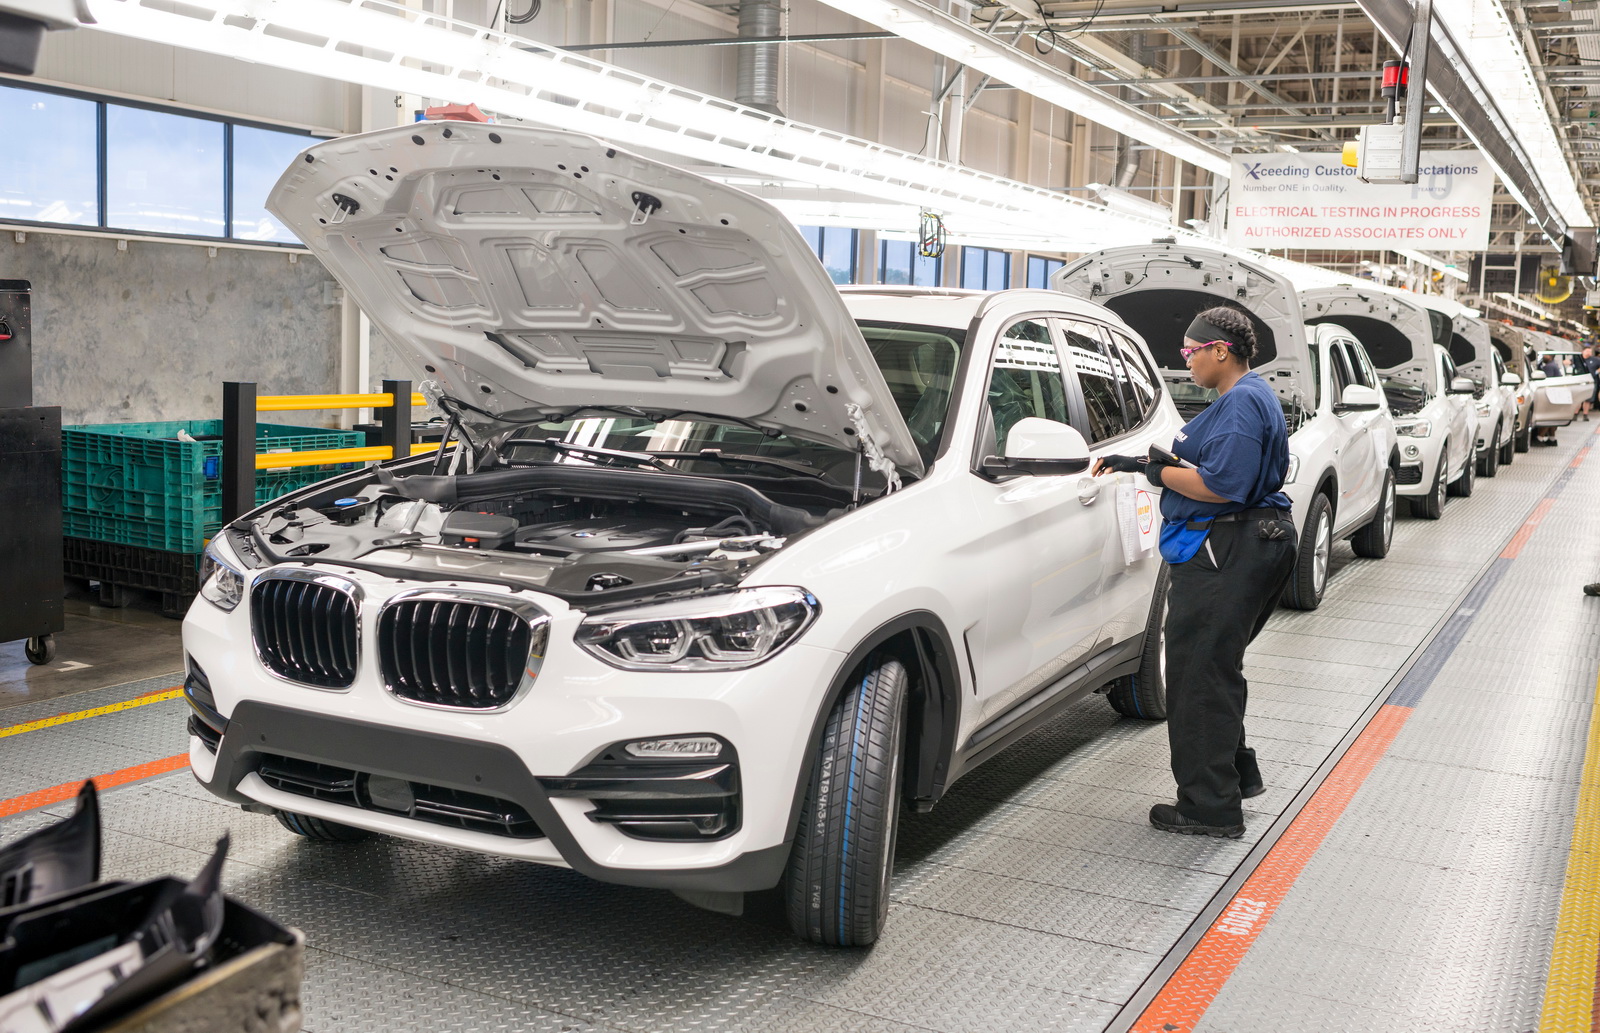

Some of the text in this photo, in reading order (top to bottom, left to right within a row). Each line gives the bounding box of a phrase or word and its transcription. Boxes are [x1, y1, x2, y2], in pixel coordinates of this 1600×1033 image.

[1243, 184, 1277, 192] Number
[1278, 184, 1298, 192] ONE
[1302, 184, 1311, 192] in
[1235, 206, 1480, 217] ELECTRICAL TESTING IN PROGRESS
[1245, 226, 1468, 238] AUTHORIZED ASSOCIATES ONLY
